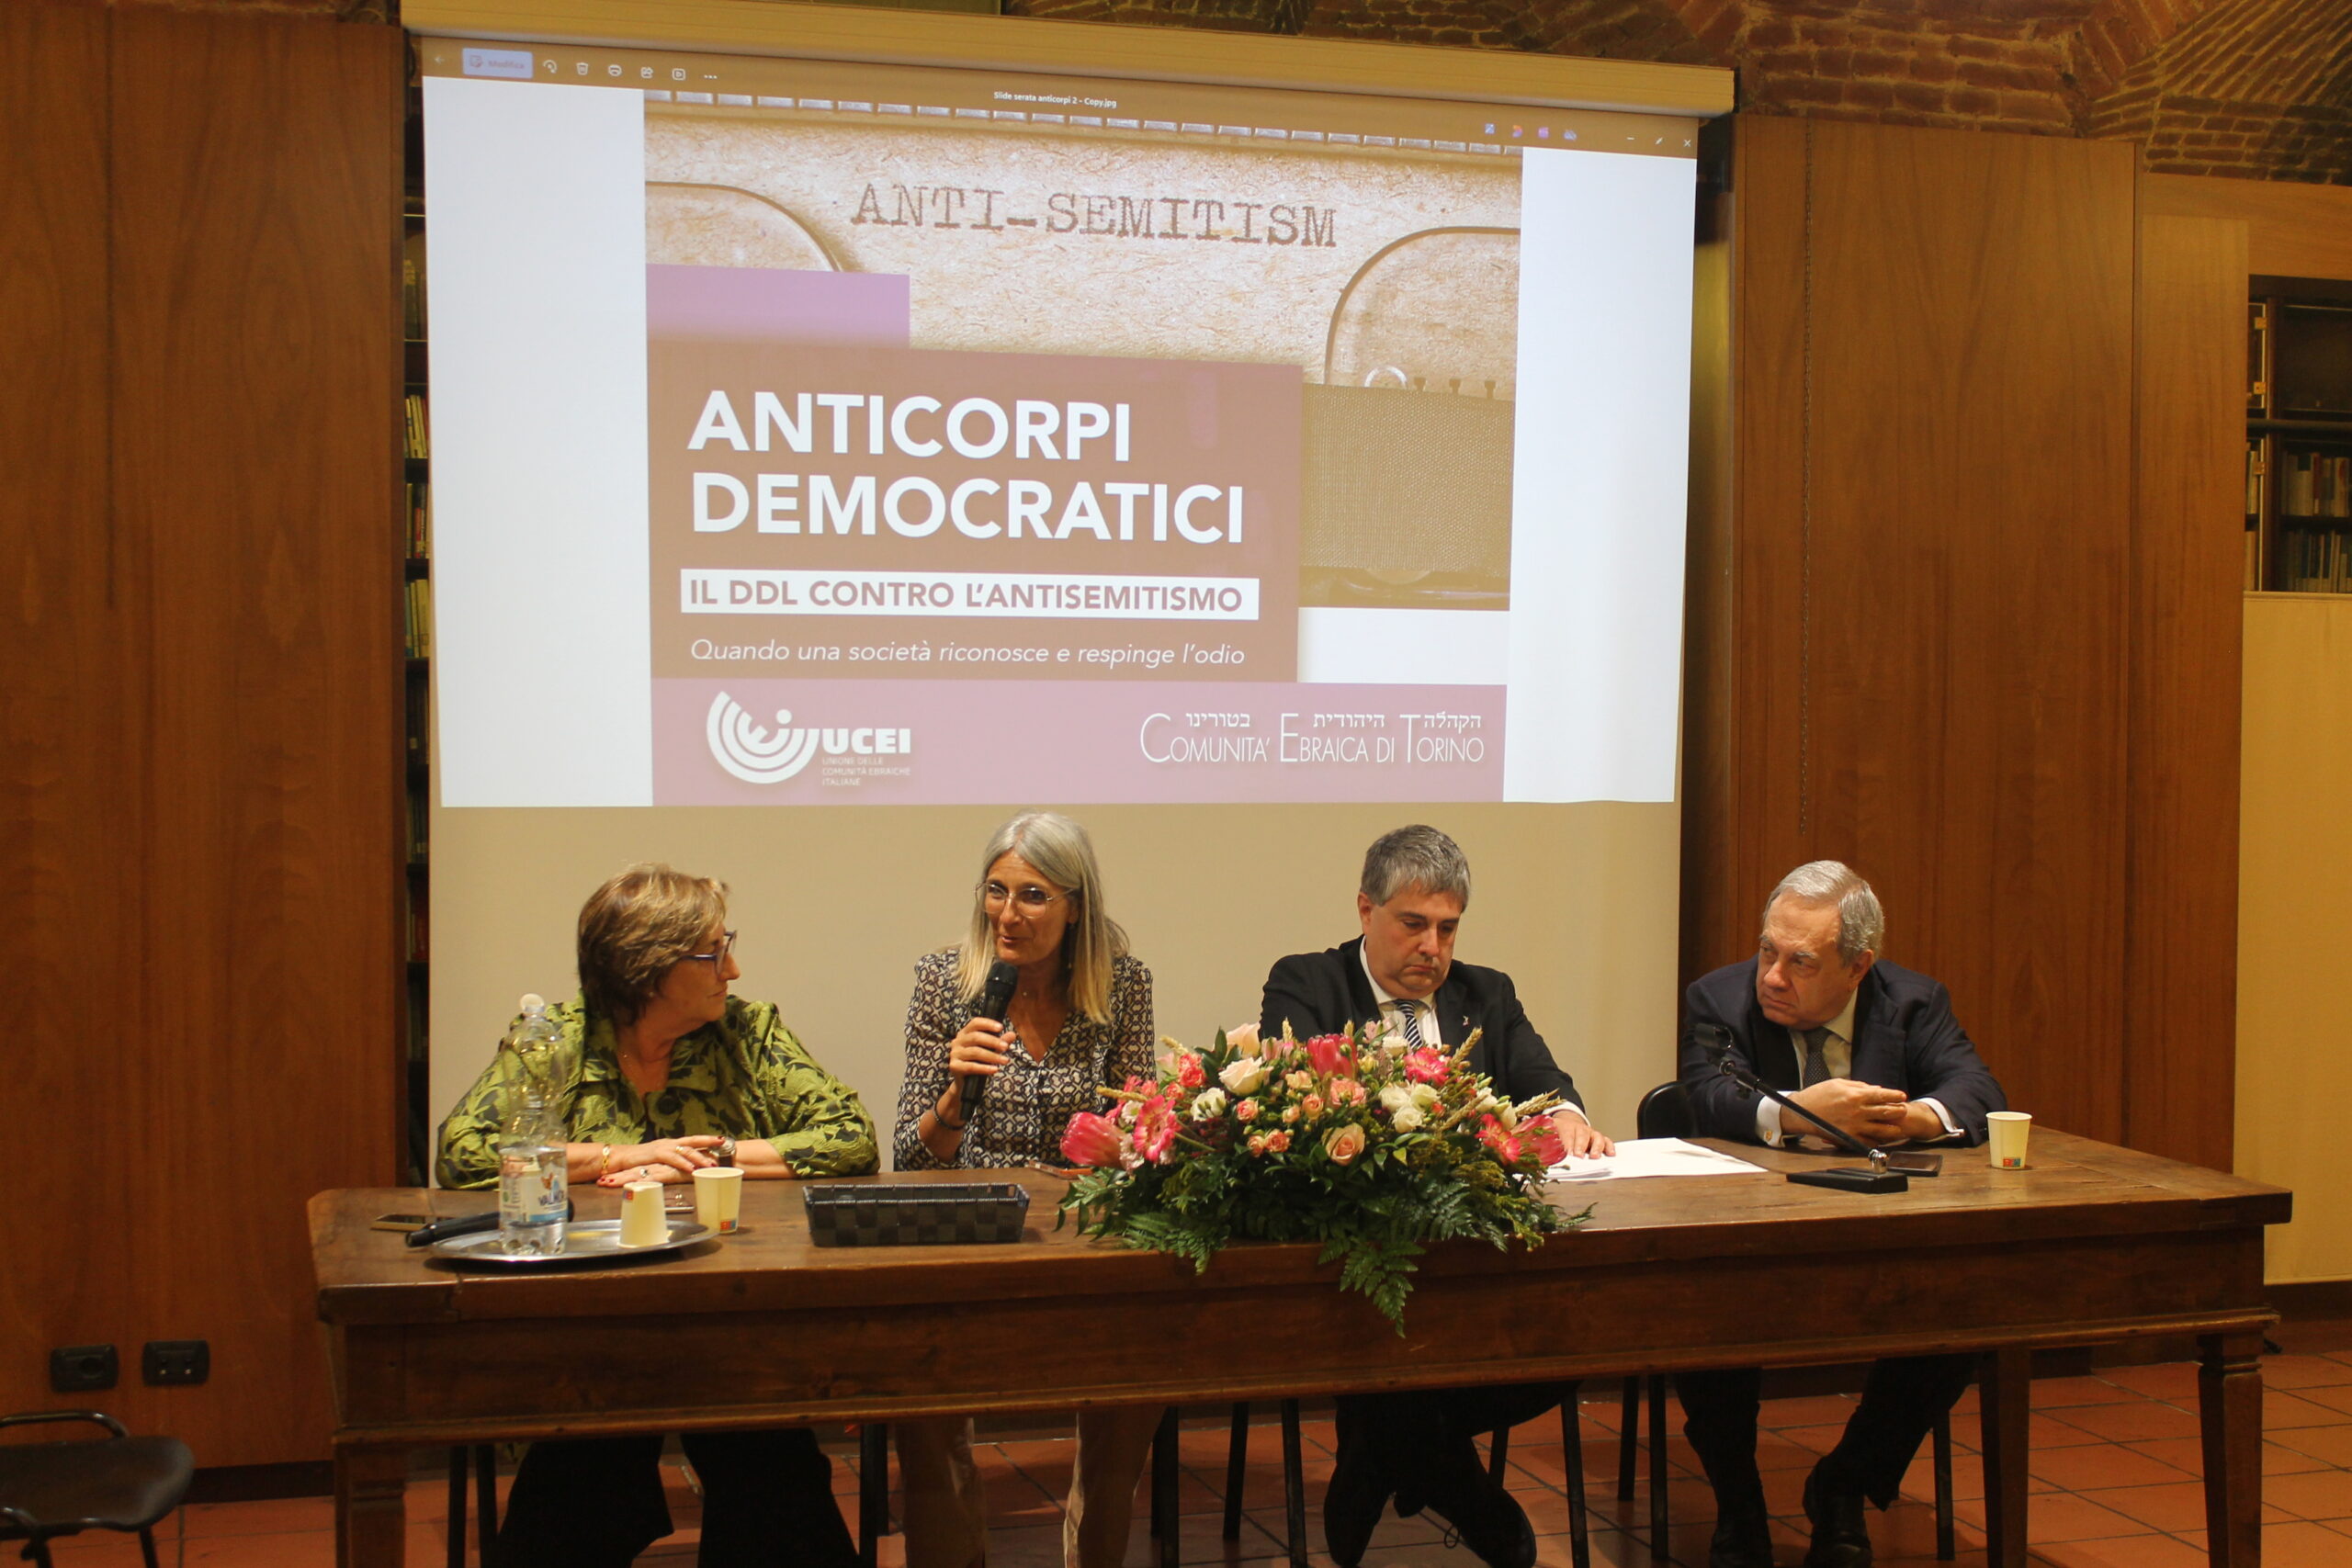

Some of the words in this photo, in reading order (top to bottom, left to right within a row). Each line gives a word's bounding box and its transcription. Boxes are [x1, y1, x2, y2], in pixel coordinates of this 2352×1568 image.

[993, 91, 1012, 100] Slide
[1013, 93, 1036, 102] serata
[1038, 95, 1071, 105] anticorpi
[1072, 96, 1078, 105] 2
[1084, 97, 1117, 108] Copy.jpg
[687, 389, 1131, 462] ANTICORPI
[693, 471, 1244, 544] DEMOCRATICI
[690, 581, 718, 605] IL
[729, 581, 797, 606] DDL
[808, 581, 955, 608] CONTRO
[690, 638, 790, 663] Quando
[797, 646, 841, 662] una
[848, 640, 932, 663] società
[938, 643, 1049, 663] riconosce
[1057, 649, 1071, 663] e
[1077, 644, 1176, 671] respinge
[822, 728, 911, 755] UCEI
[1376, 737, 1395, 763] DI
[1399, 714, 1485, 763] TORINO
[822, 757, 855, 765] UNIONE
[858, 757, 884, 765] DELLE
[822, 766, 866, 776] COMUNITÀ
[869, 768, 911, 777] EBRAICHE
[822, 778, 861, 786] ITALIANE
